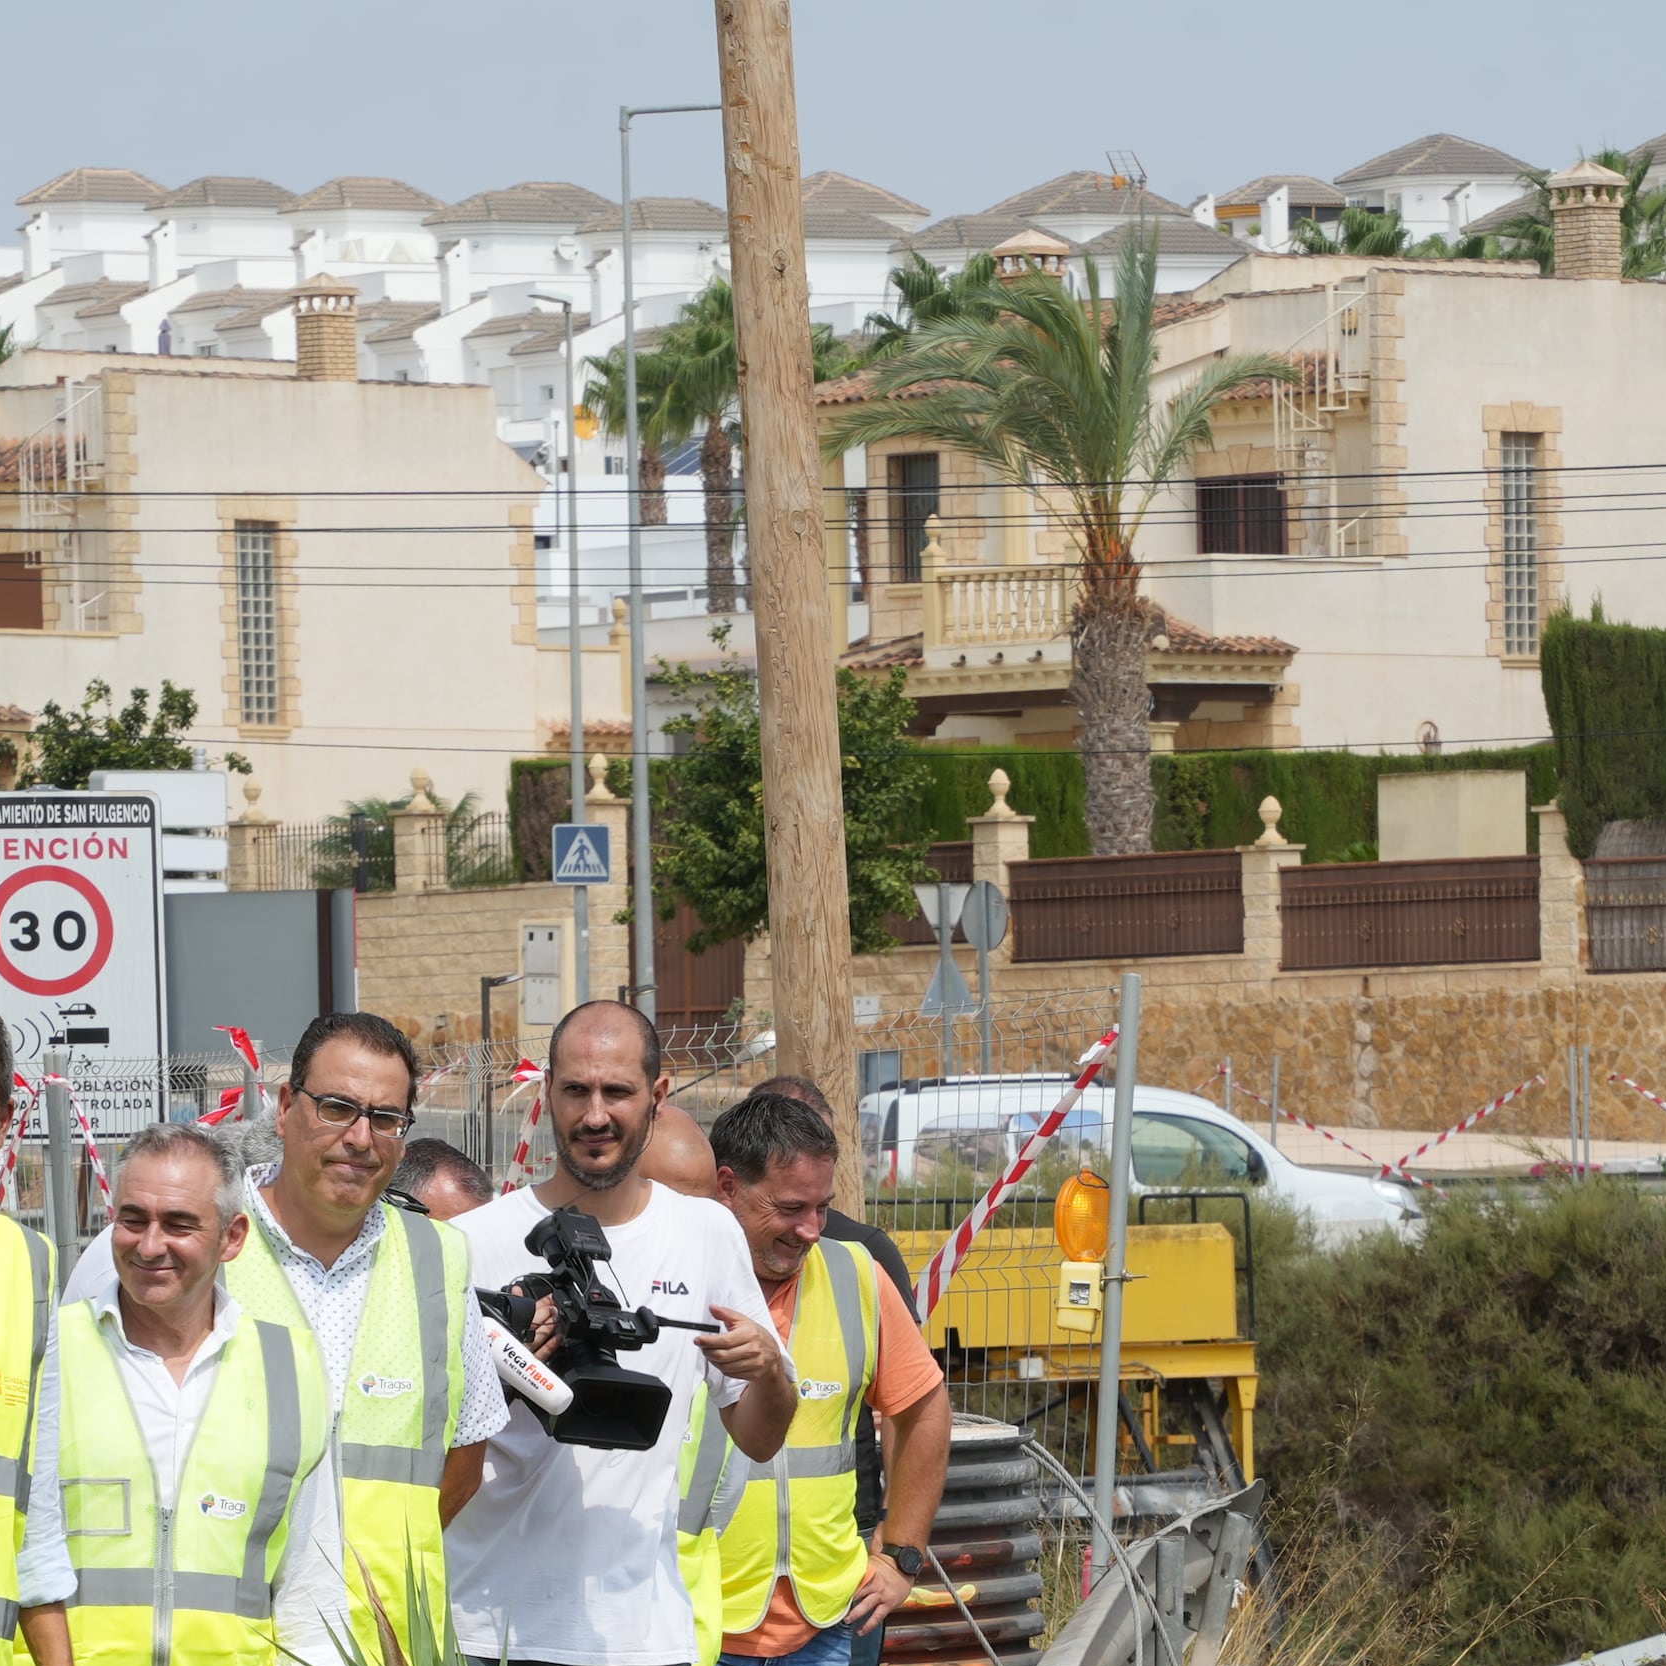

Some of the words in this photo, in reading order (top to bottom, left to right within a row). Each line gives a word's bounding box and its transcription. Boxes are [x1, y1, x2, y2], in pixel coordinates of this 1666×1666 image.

[46, 803, 62, 824] DE
[63, 803, 86, 824] SAN
[88, 803, 151, 824] FULGENCIO
[9, 910, 87, 952] 30
[73, 1076, 153, 1092] OBLACIÓN
[68, 1098, 153, 1110] NTROLADA
[651, 1280, 690, 1296] FILA
[379, 1377, 412, 1392] Tragsa
[814, 1382, 841, 1394] Tragsa
[219, 1498, 246, 1515] Trag
